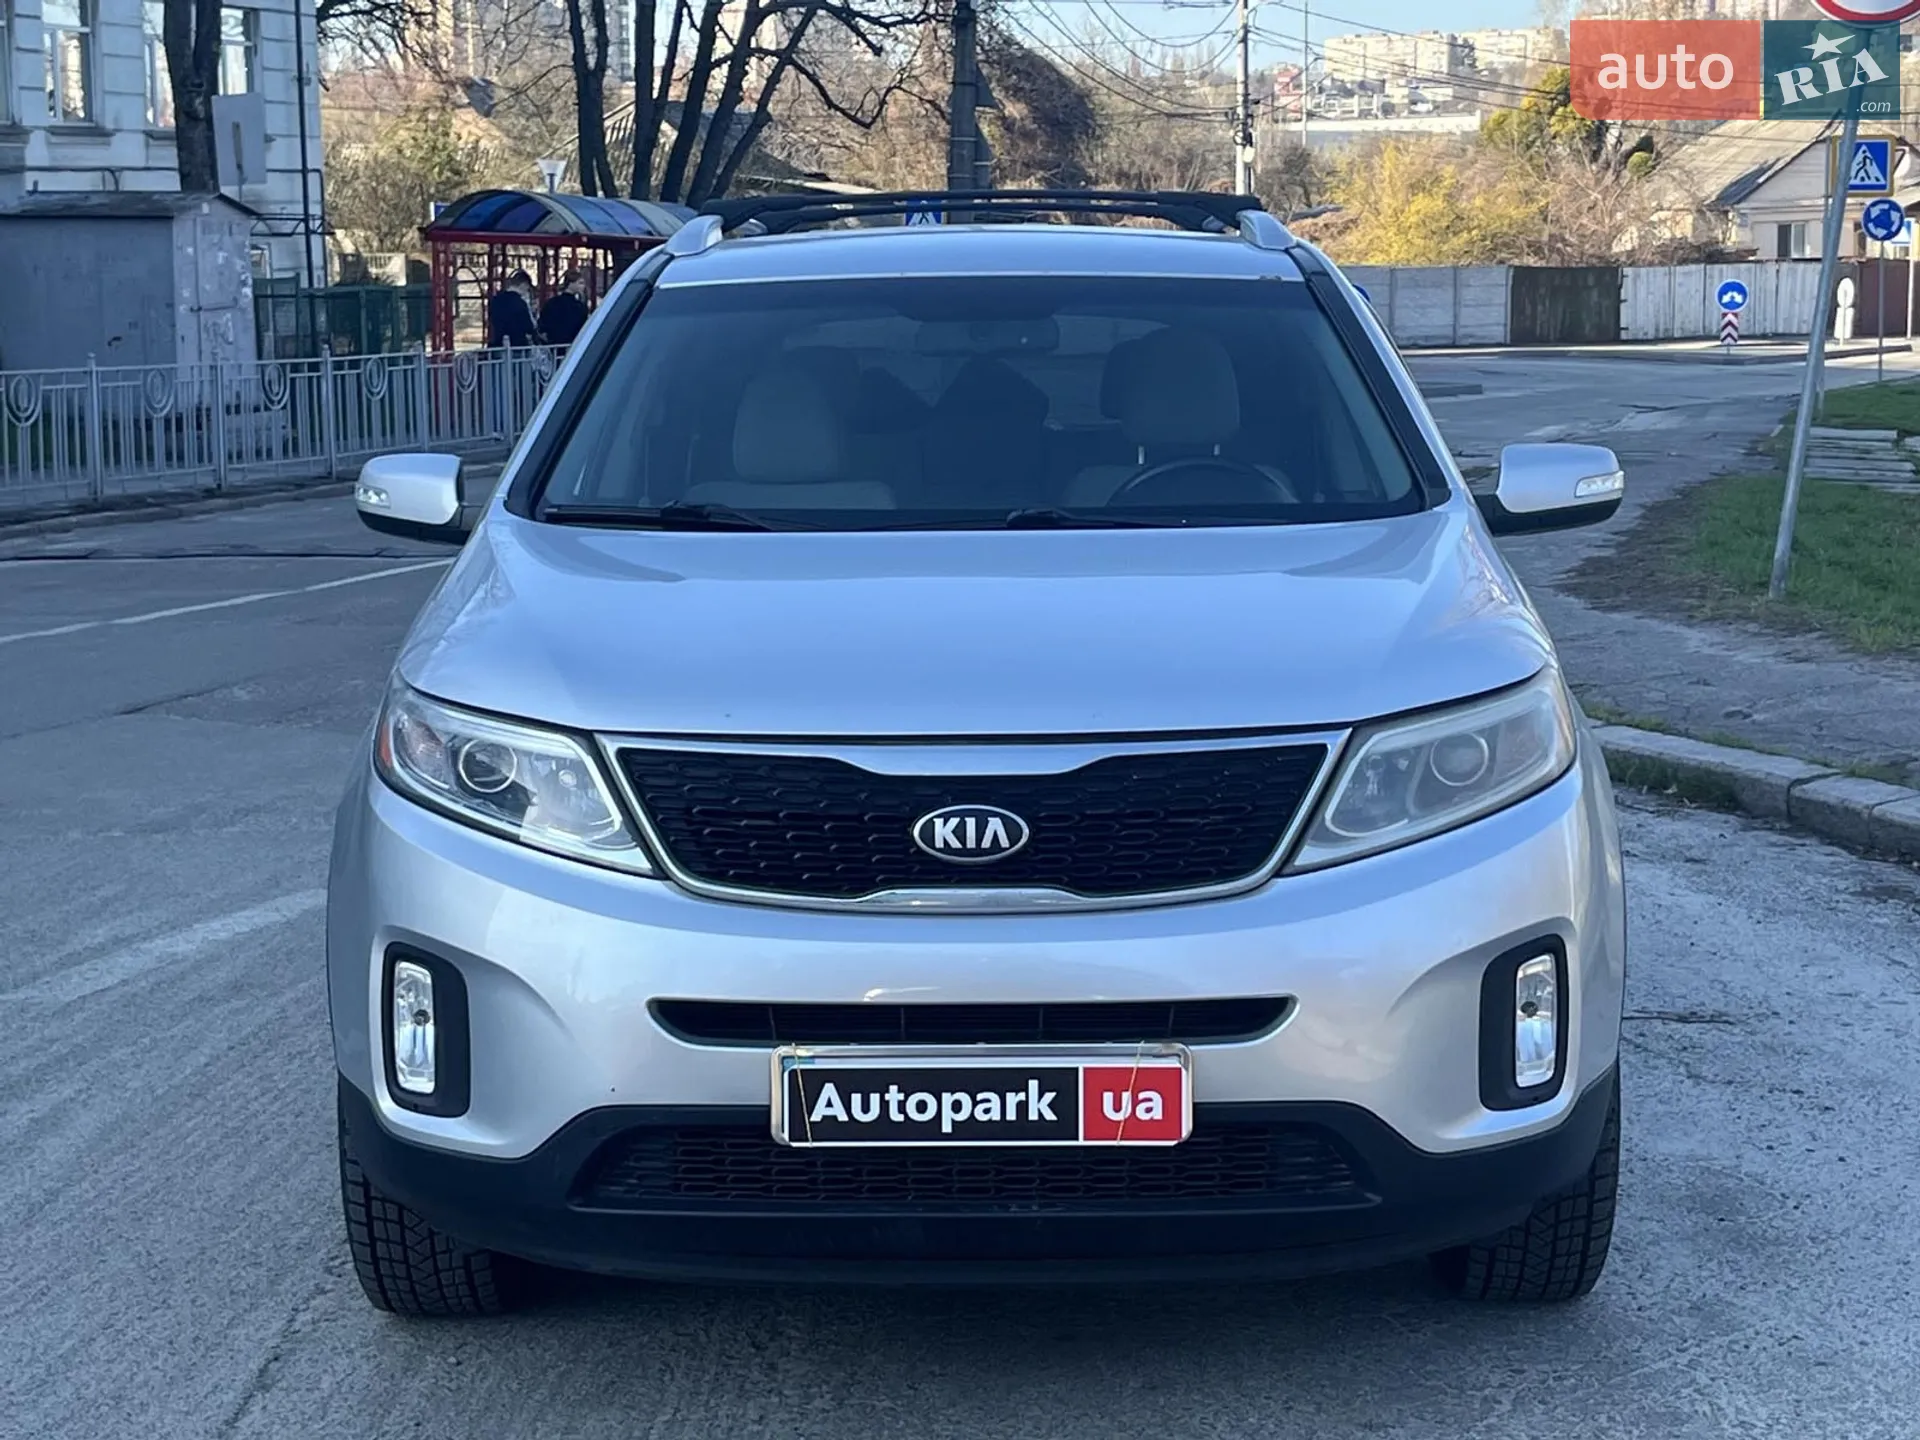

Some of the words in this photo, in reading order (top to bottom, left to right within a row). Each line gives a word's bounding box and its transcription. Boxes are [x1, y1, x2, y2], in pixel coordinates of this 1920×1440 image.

[932, 816, 1011, 849] KIA
[809, 1079, 1058, 1134] Autopark
[1101, 1089, 1164, 1122] ua
